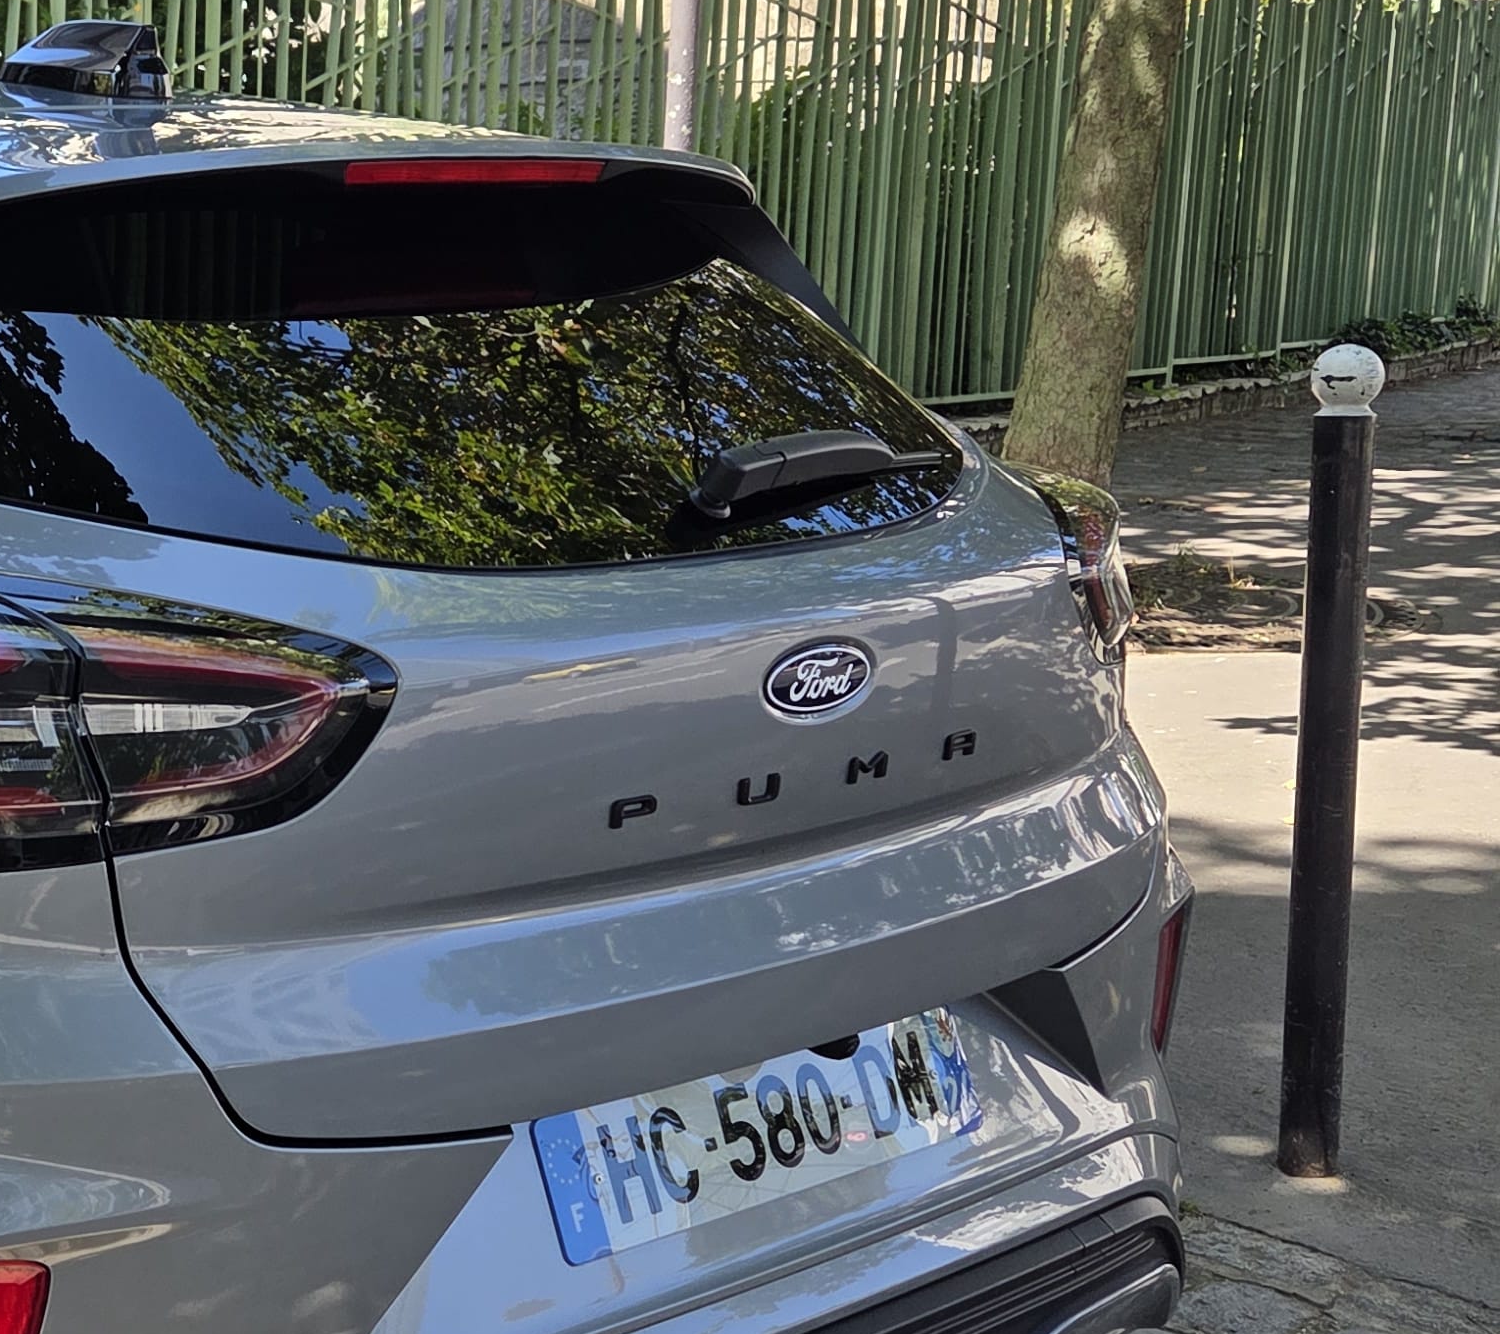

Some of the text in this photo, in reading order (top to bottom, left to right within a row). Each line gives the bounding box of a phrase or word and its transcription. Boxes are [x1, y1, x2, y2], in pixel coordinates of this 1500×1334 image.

[789, 657, 854, 702] Ford
[608, 728, 977, 829] PUMA
[570, 1201, 585, 1233] F
